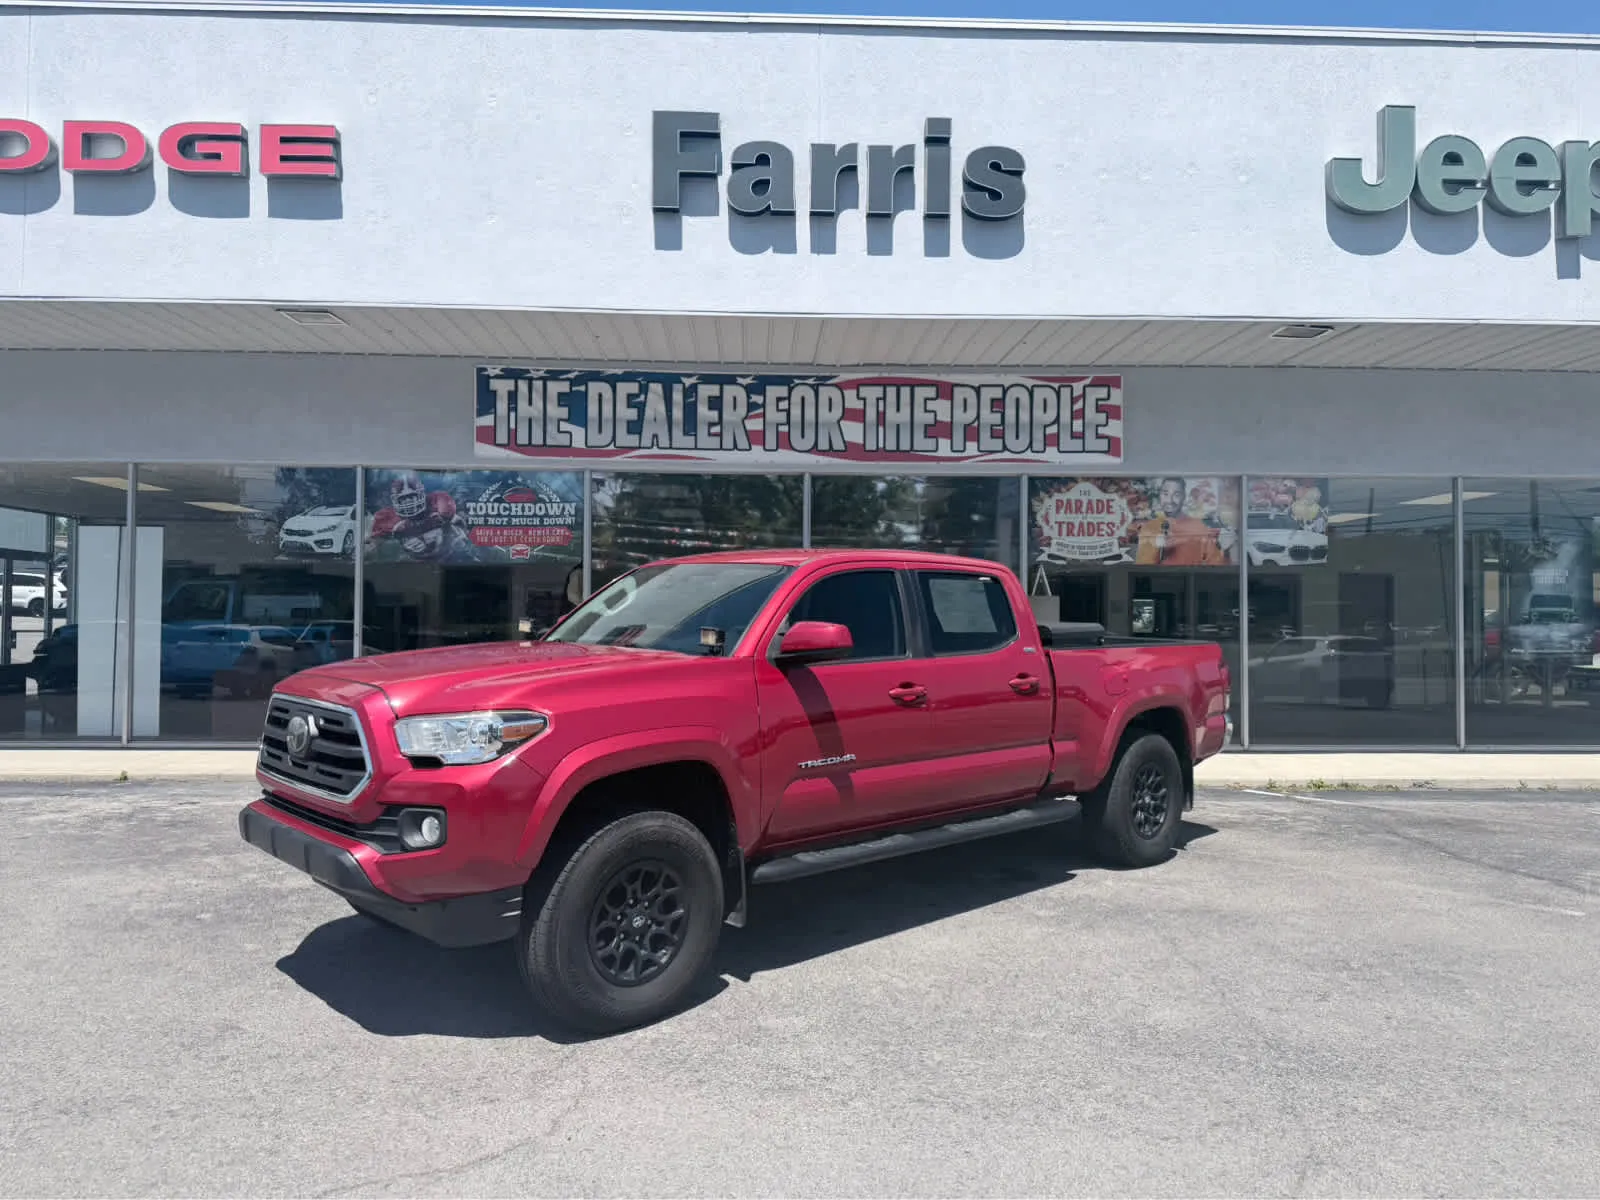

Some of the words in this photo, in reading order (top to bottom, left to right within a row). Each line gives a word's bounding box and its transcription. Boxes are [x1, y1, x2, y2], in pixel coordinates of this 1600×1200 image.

[652, 110, 1026, 221] Farris
[489, 377, 573, 448] THE
[584, 380, 752, 451] DEALER
[763, 383, 848, 453] FOR
[857, 384, 939, 453] THE
[950, 384, 1111, 454] PEOPLE
[466, 502, 577, 516] TOUCHDOWN
[1055, 499, 1116, 514] PARADE
[468, 517, 485, 525] FOR
[488, 517, 509, 525] NOT
[511, 517, 541, 526] MUCH
[1055, 521, 1116, 537] TRADES
[797, 753, 857, 769] TACOMA
